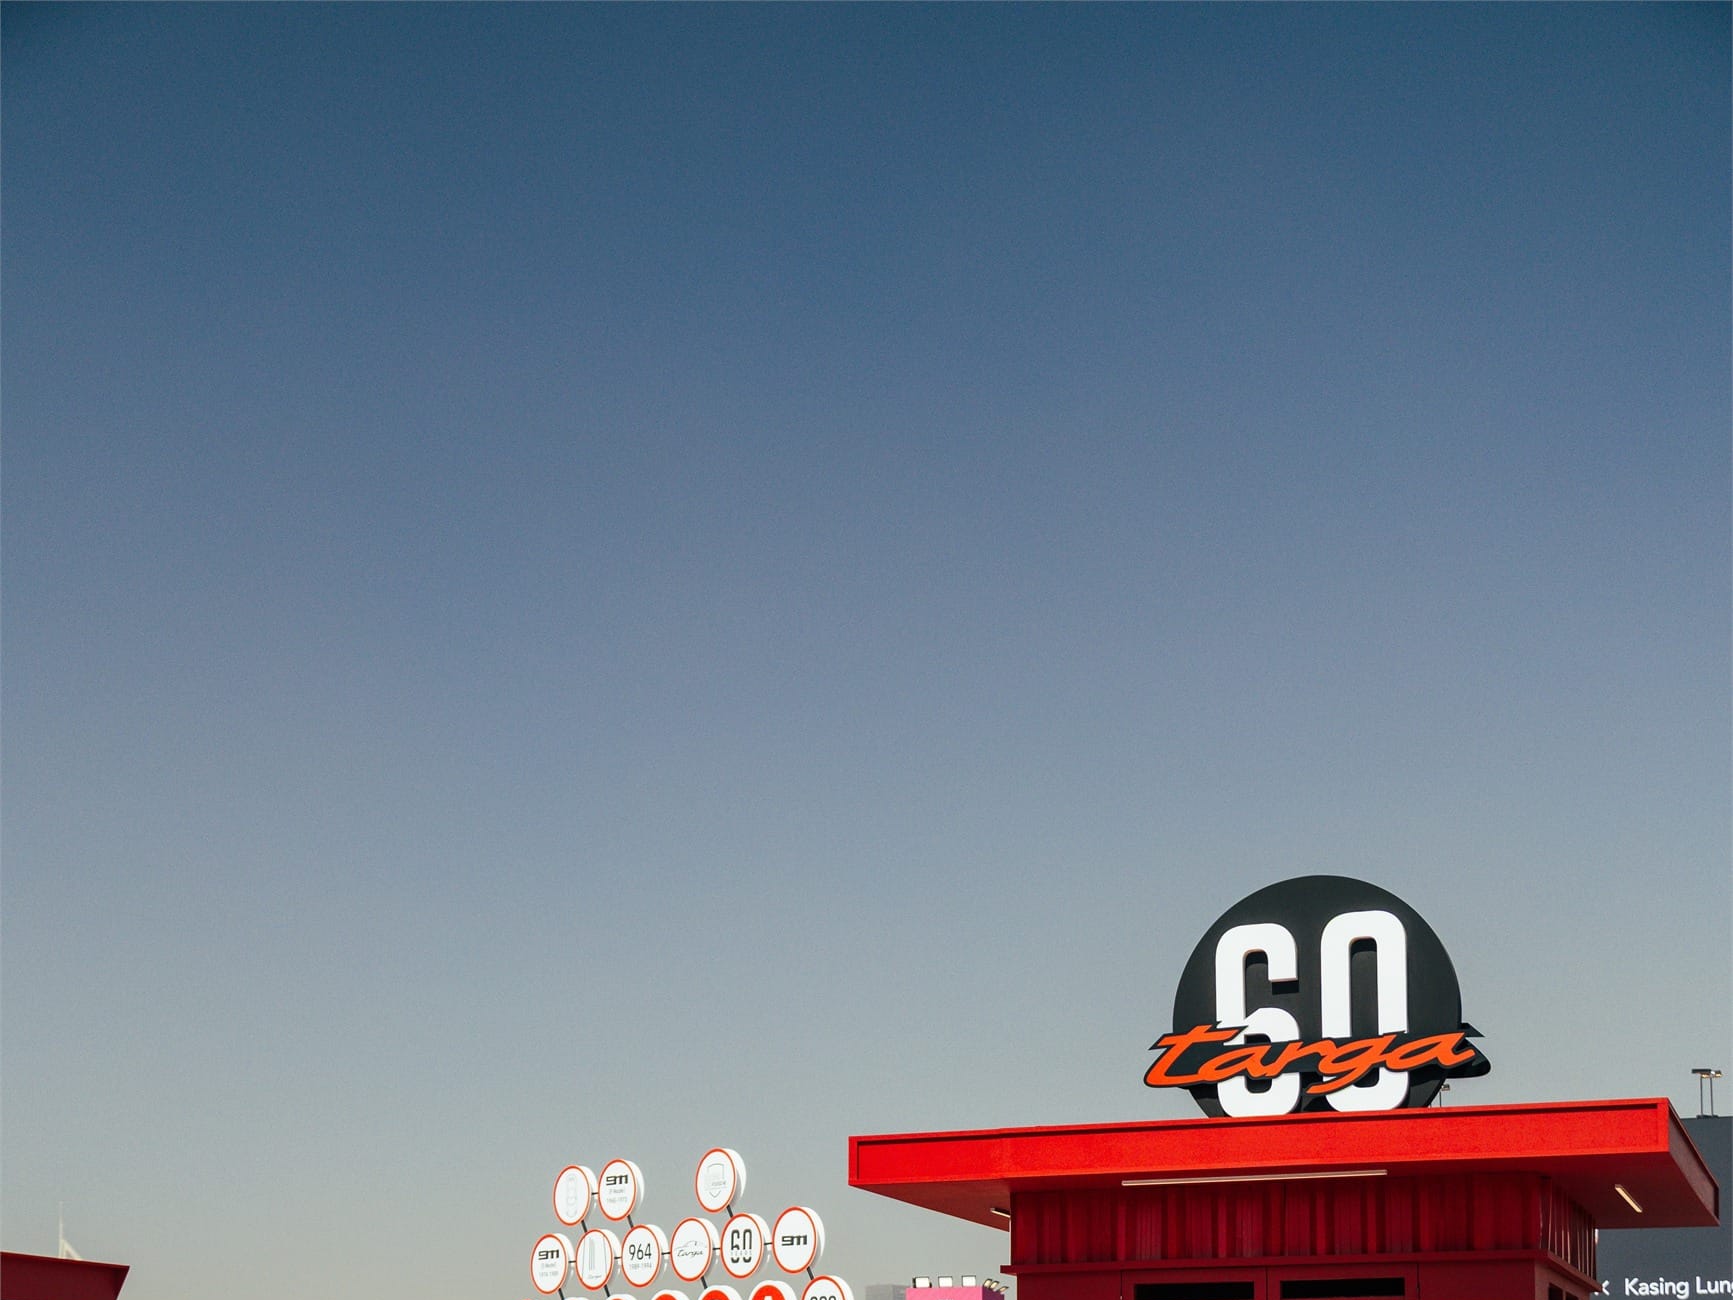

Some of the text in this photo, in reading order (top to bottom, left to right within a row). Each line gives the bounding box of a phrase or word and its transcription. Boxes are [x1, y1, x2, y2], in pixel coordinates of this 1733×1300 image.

[1215, 910, 1409, 1118] 60
[1145, 1024, 1476, 1094] targa
[605, 1174, 629, 1186] 911
[781, 1234, 808, 1246] 911
[538, 1249, 560, 1261] 911
[628, 1243, 653, 1261] 964
[1624, 1277, 1690, 1300] Kasing
[1696, 1276, 1733, 1297] Lun
